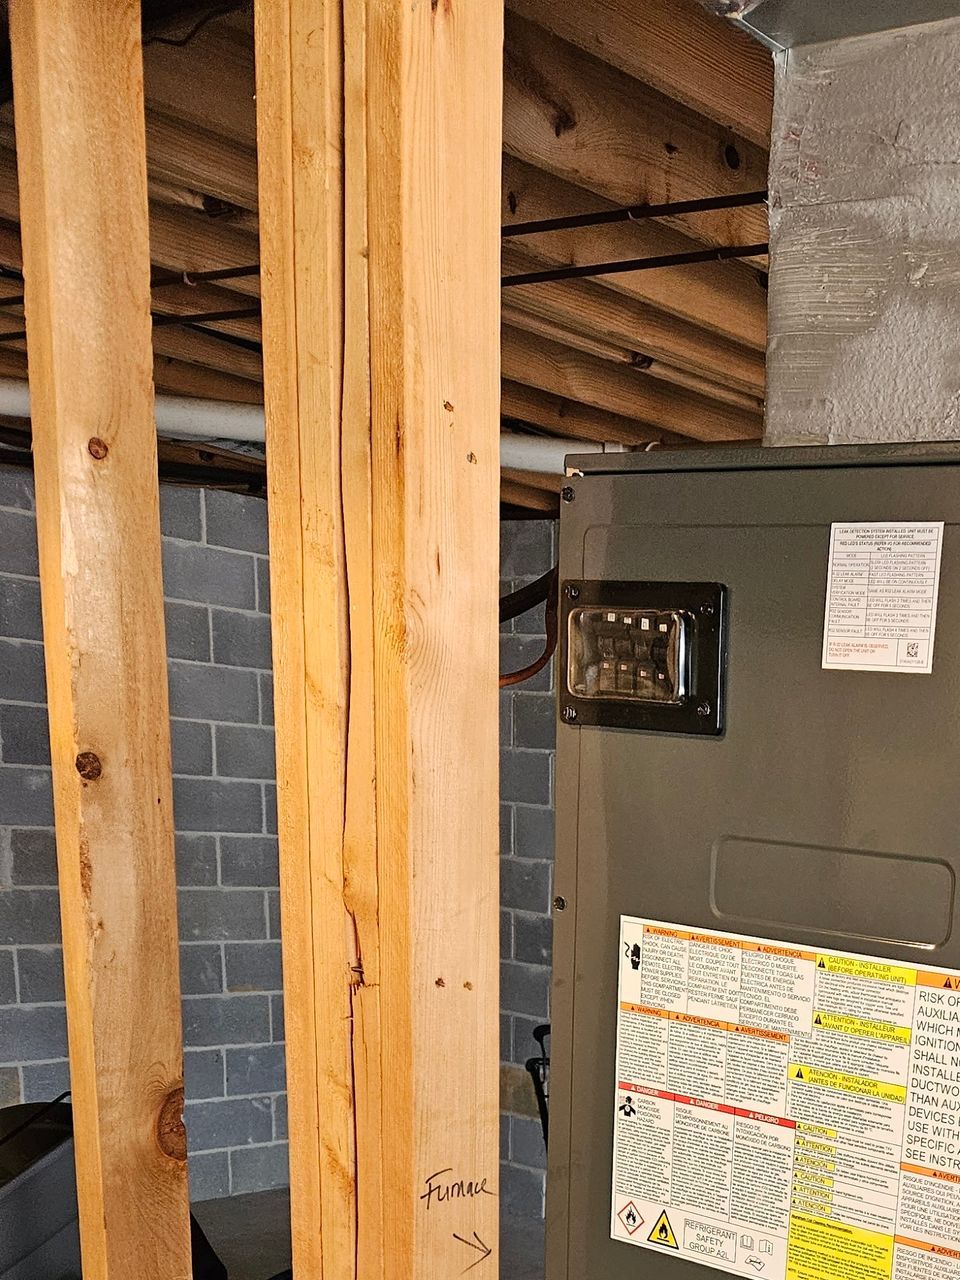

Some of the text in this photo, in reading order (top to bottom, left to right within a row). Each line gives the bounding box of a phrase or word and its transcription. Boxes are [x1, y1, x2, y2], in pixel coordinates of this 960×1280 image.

[653, 928, 677, 937] WARNING
[695, 935, 740, 947] AVERTISSEMENT
[762, 946, 801, 957] ADVERTENCIA
[828, 957, 891, 973] CAUTION INSTALLER
[827, 964, 906, 983] (BEFORE OPERATING UNIT)
[918, 990, 944, 1004] RISK
[637, 1006, 661, 1015] WARNING
[682, 1015, 719, 1027] ADVERTENCIA
[822, 1014, 895, 1033] ATTENTION INSTALLEUR
[916, 1019, 953, 1036] WHICH
[740, 1026, 786, 1040] AVERTISSEMENT
[913, 1049, 947, 1065] SHALL
[808, 1076, 828, 1086] (ANTES
[839, 1083, 871, 1095] FUNCIONAR
[880, 1091, 904, 1102] UNIDAD)
[842, 1076, 877, 1088] INSTALADOR
[636, 1086, 658, 1096] DANGER
[695, 1099, 718, 1110] DANGER
[909, 1091, 938, 1107] THAN
[754, 1113, 779, 1124] PELIGRO
[908, 1106, 955, 1125] DEVICES
[802, 1124, 827, 1135] CAUTION
[907, 1120, 928, 1134] USE
[931, 1125, 960, 1140] WITH
[801, 1140, 832, 1153] ATTENTION
[906, 1134, 955, 1154] SPECIFIC
[905, 1148, 926, 1162] SEE
[800, 1173, 825, 1184] CAUTION
[420, 1167, 498, 1210] Furnace
[798, 1186, 829, 1199] ATTENTION
[685, 1220, 735, 1240] REFRIGERANT
[695, 1233, 723, 1247] SAFETY
[689, 1241, 729, 1259] GROUP A2L
